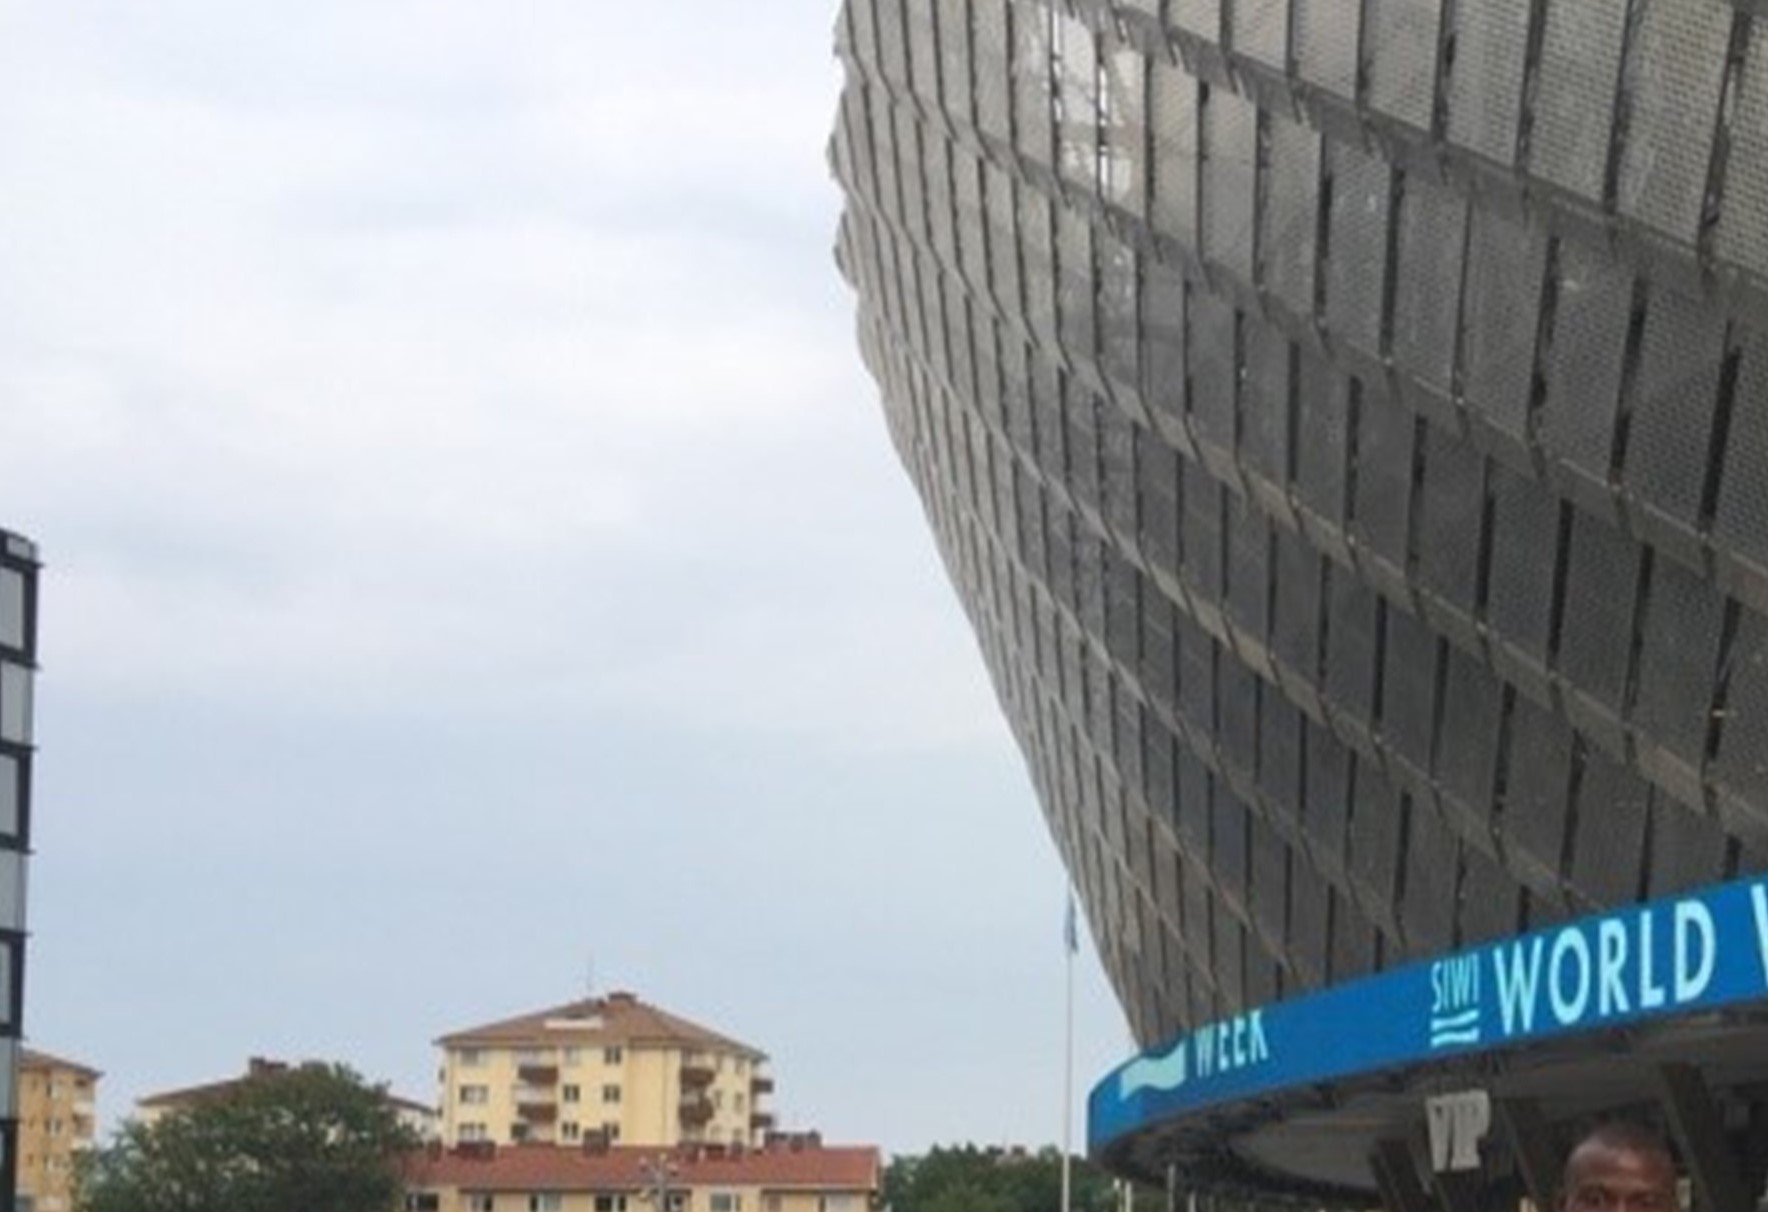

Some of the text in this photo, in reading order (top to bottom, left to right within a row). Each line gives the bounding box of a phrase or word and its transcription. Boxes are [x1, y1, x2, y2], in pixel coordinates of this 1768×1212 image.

[1431, 952, 1479, 1013] SIWI
[1493, 899, 1715, 1036] WORLD
[1194, 1008, 1268, 1078] WEEK
